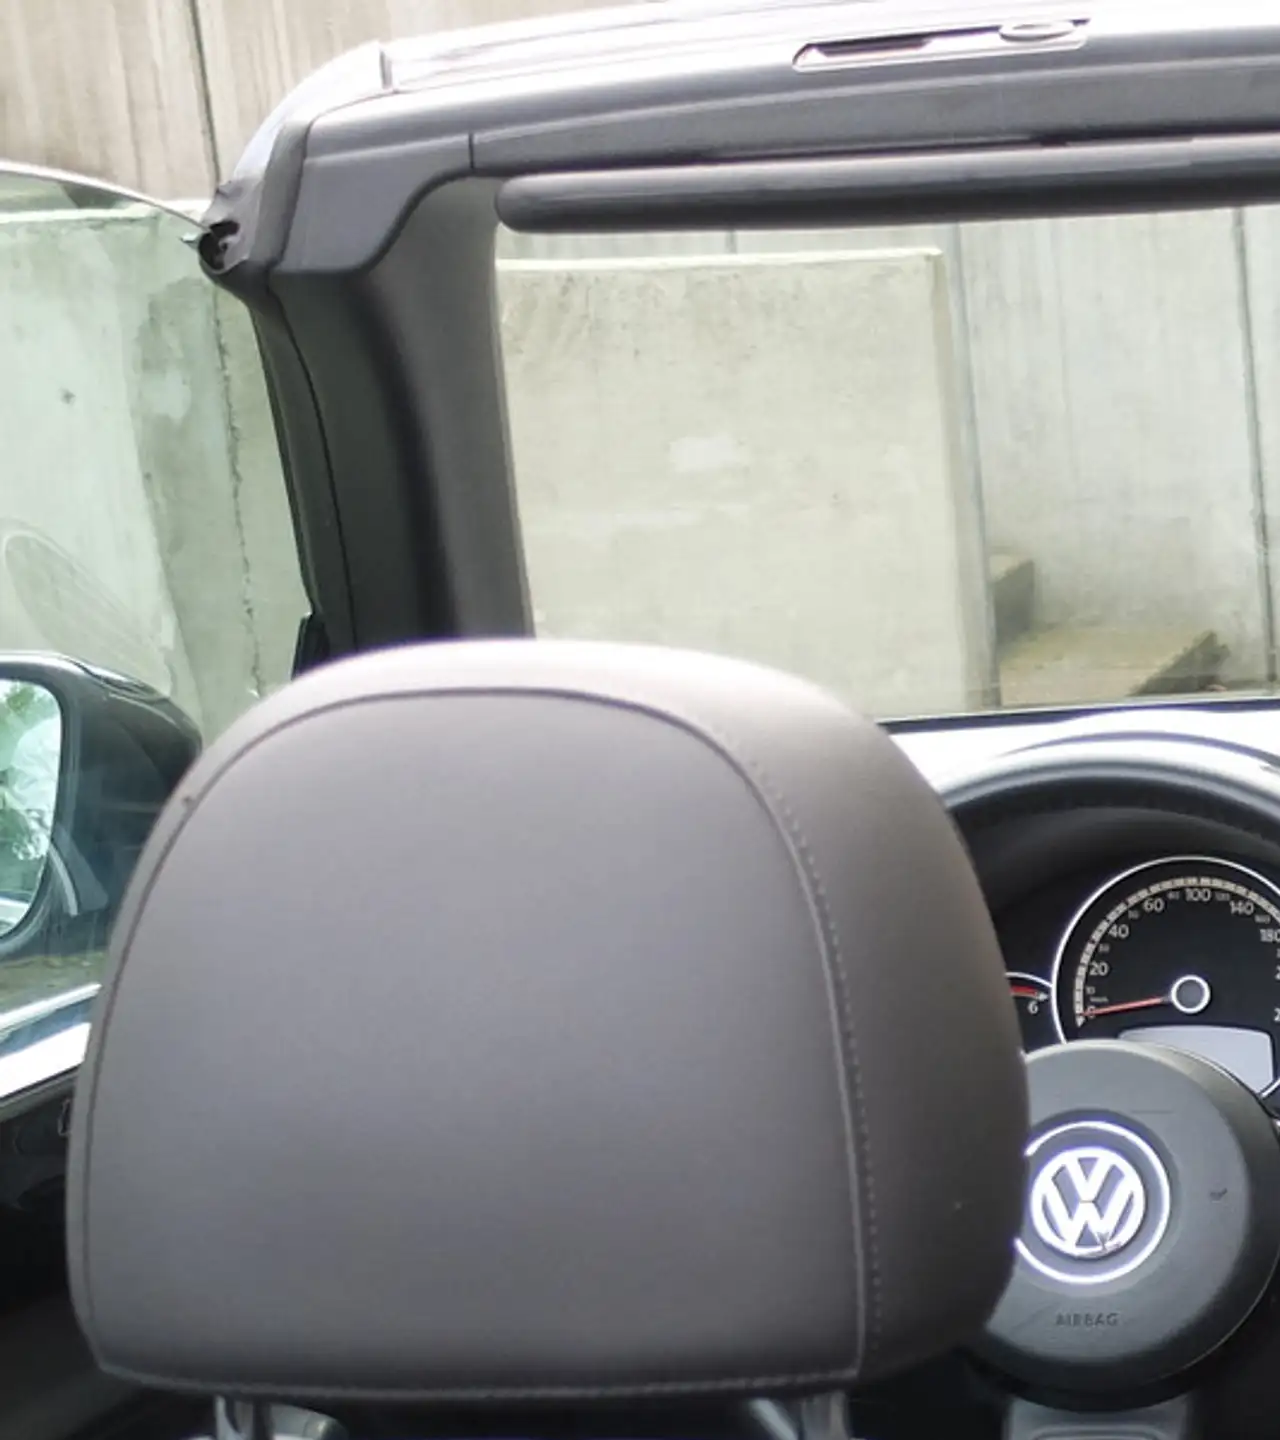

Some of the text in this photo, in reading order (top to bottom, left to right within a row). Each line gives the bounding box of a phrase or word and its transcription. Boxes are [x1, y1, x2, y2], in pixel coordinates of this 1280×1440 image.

[1184, 888, 1212, 902] 100
[1143, 899, 1165, 913] 60
[1229, 900, 1255, 915] 140
[1108, 923, 1130, 939] 40
[1089, 961, 1110, 976] 20
[1027, 1001, 1039, 1015] 6
[1056, 1312, 1119, 1327] AIRBAG
